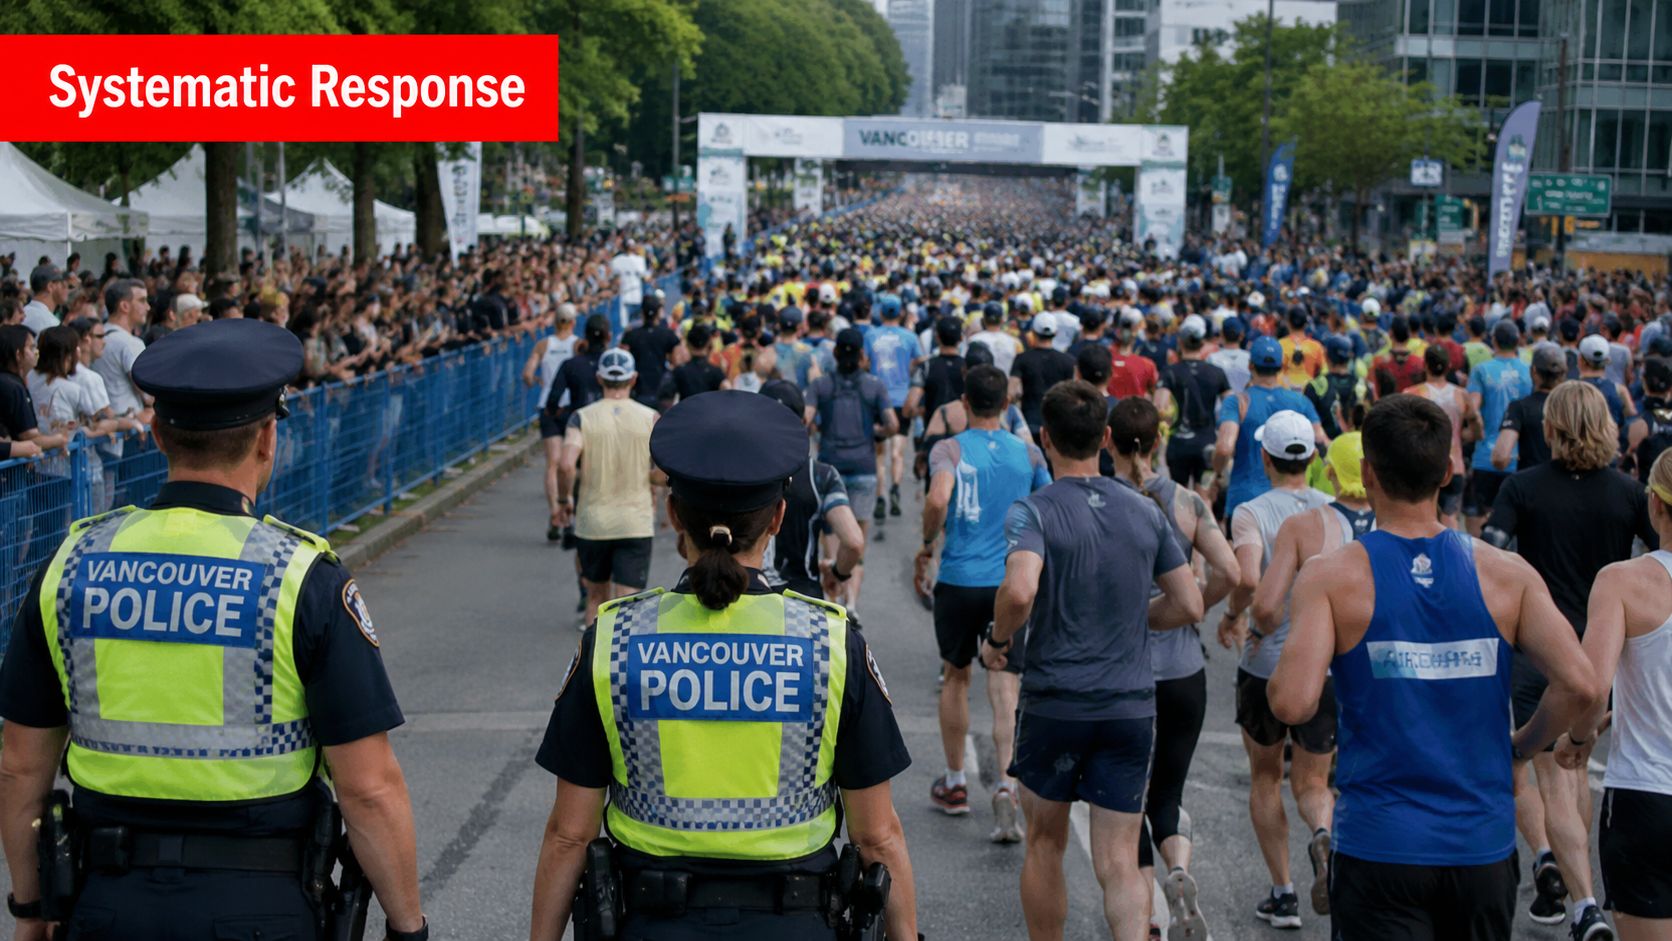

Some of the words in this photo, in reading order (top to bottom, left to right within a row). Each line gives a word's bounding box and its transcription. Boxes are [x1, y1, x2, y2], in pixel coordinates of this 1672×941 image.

[87, 560, 253, 591] VANCOUVER
[82, 587, 245, 637] POLICE
[637, 641, 804, 667] VANCOUVER
[640, 668, 801, 712] POLICE
